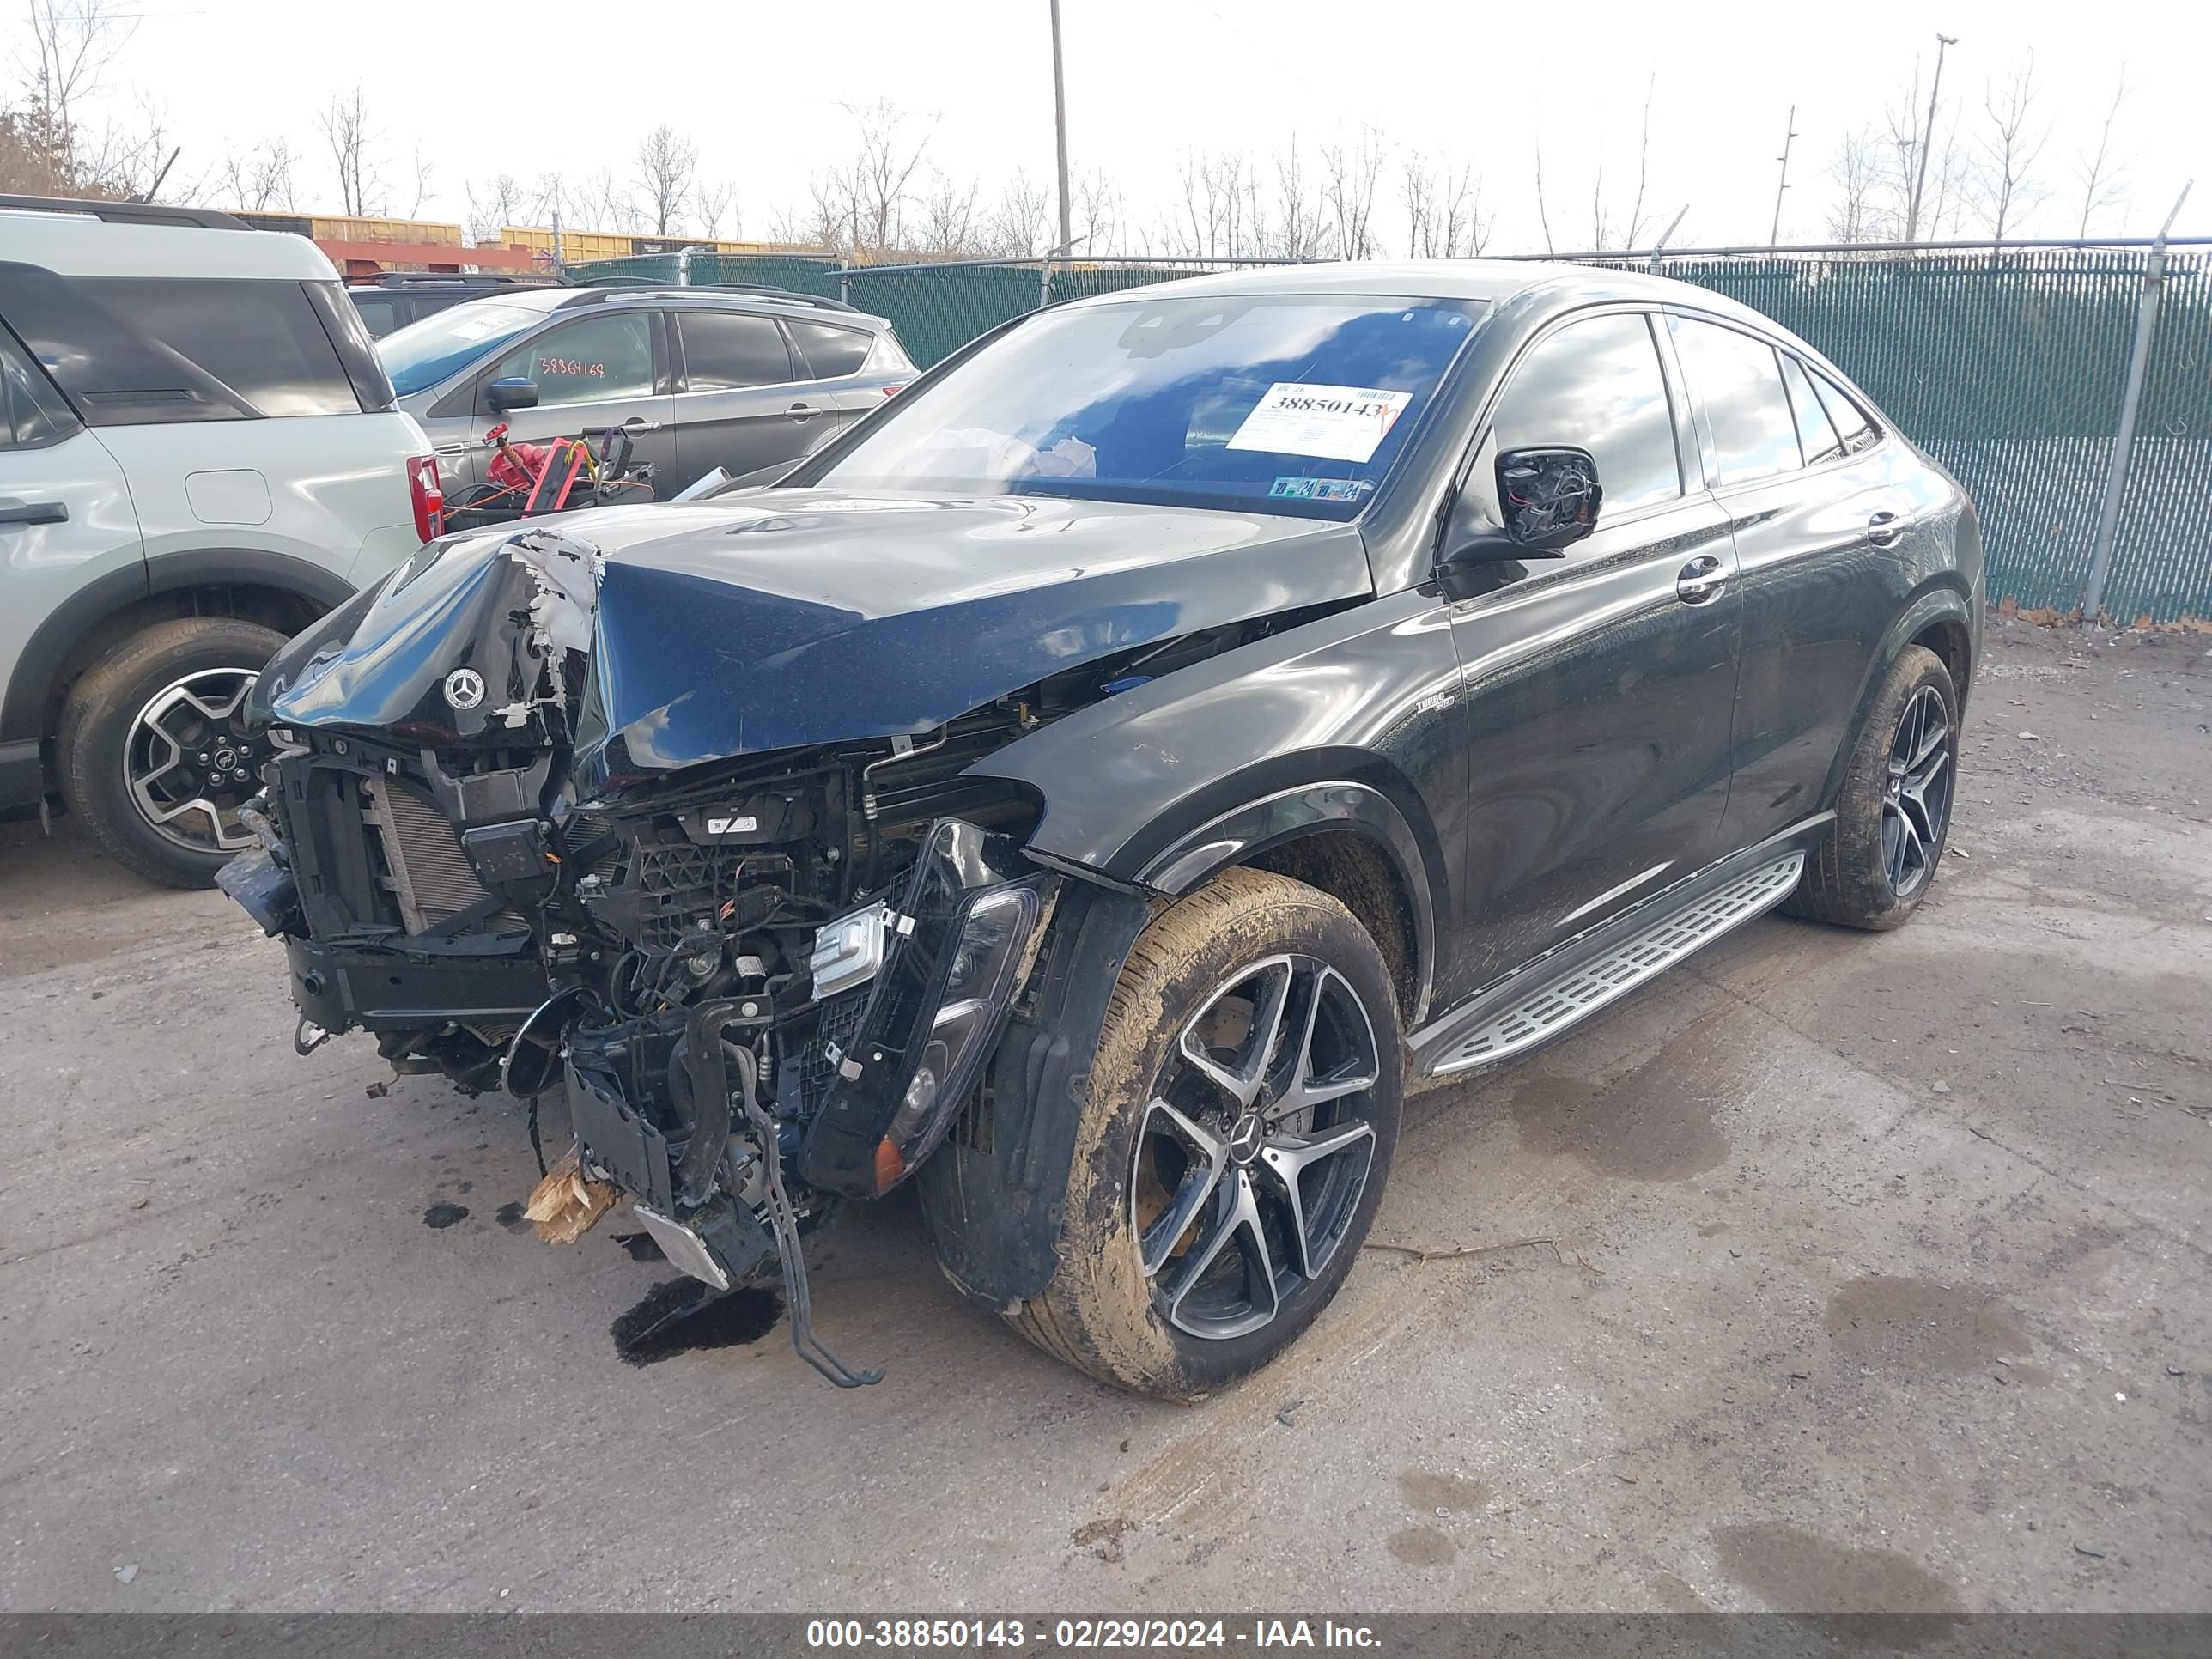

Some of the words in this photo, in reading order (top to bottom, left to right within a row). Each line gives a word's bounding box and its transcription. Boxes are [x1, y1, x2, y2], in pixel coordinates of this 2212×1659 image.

[539, 357, 605, 378] 38864169
[1272, 397, 1383, 417] 38850143
[1300, 481, 1316, 495] 24
[1344, 483, 1360, 499] 24
